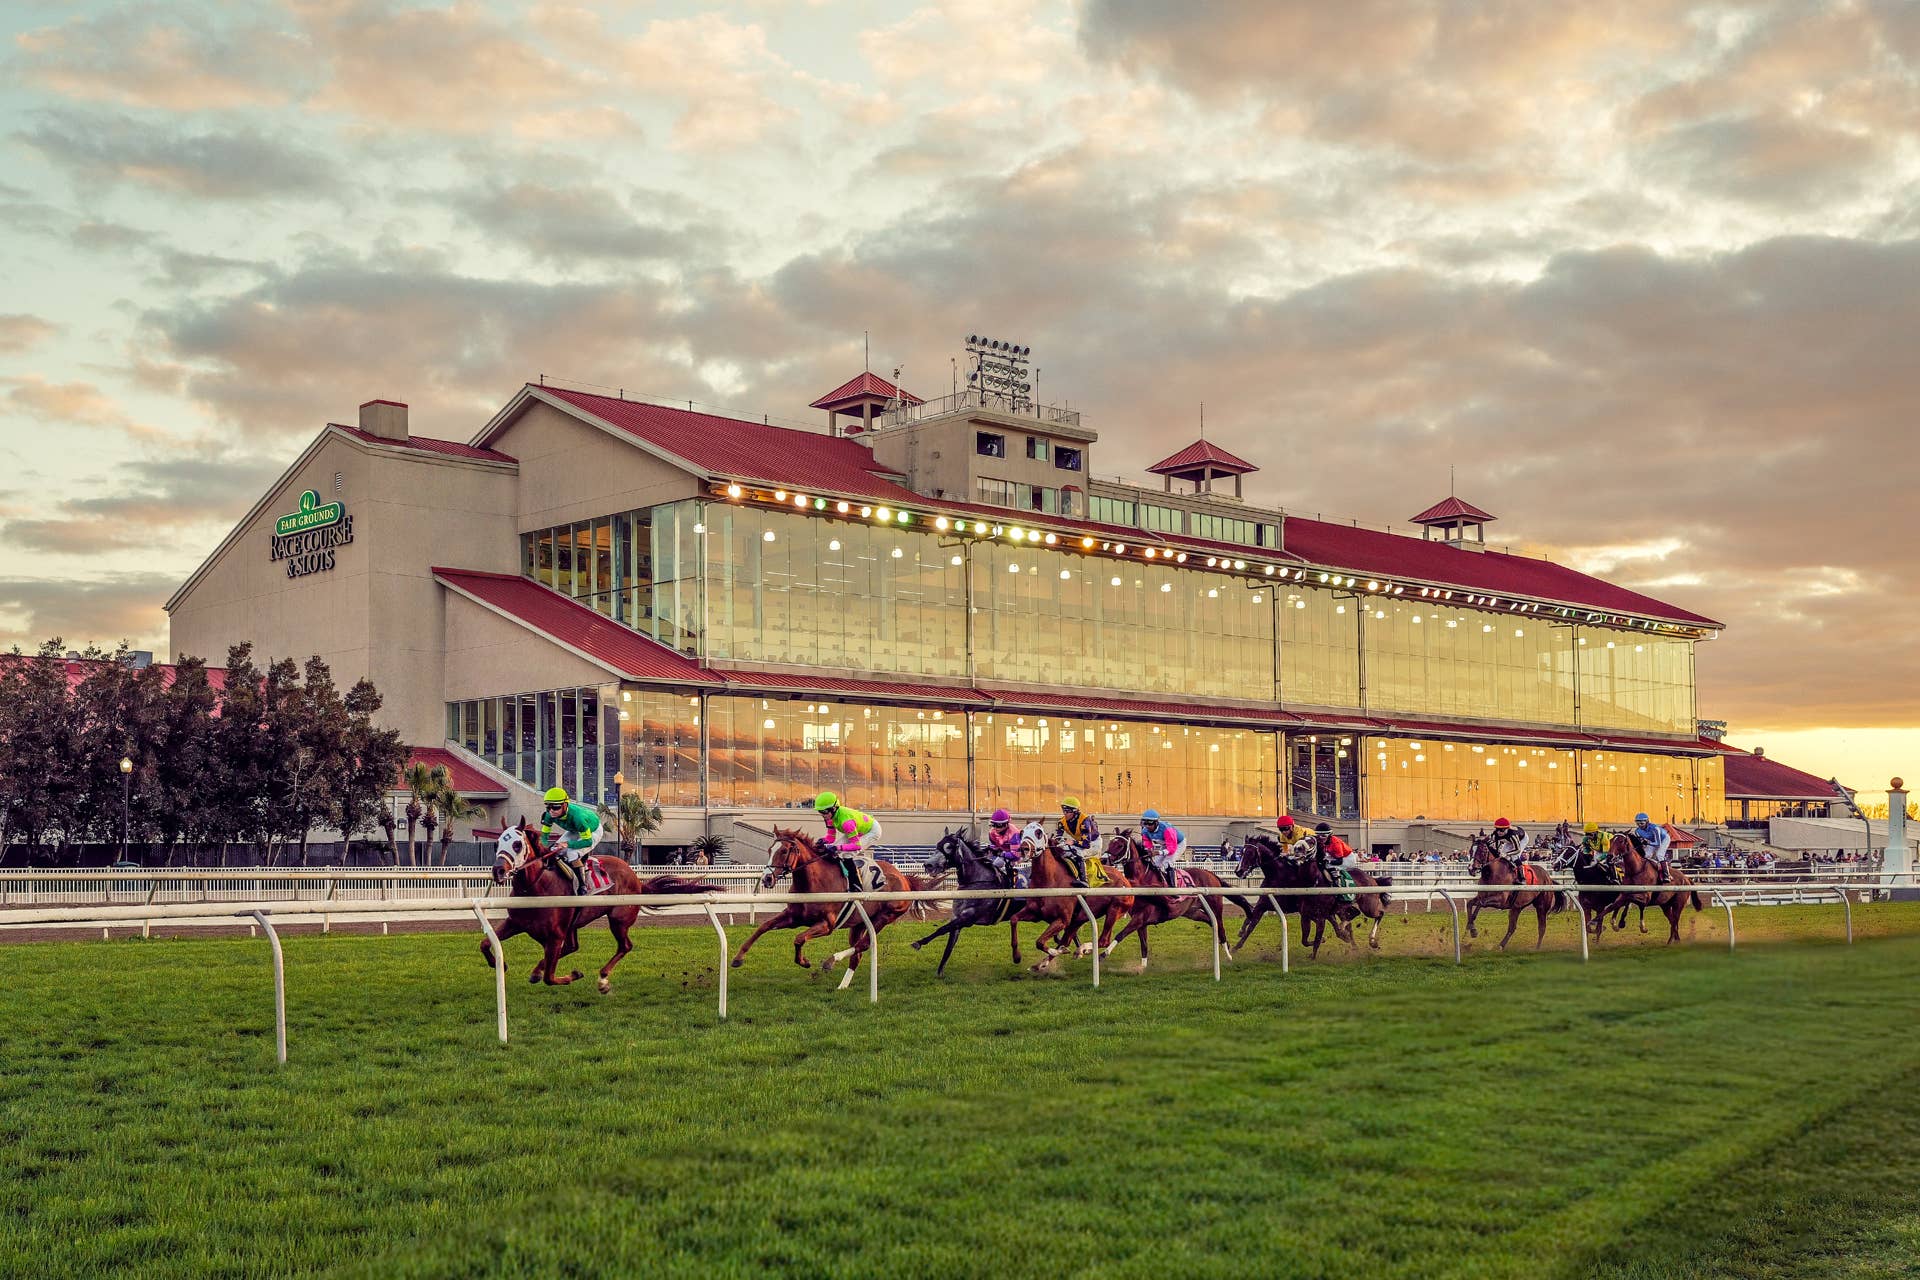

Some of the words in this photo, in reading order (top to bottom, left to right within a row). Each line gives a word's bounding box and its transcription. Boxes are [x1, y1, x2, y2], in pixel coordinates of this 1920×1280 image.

[280, 518, 297, 531] FAIR
[298, 508, 335, 526] GROUNDS
[287, 558, 296, 577] &
[296, 549, 335, 576] SLOTS
[869, 865, 885, 889] 2
